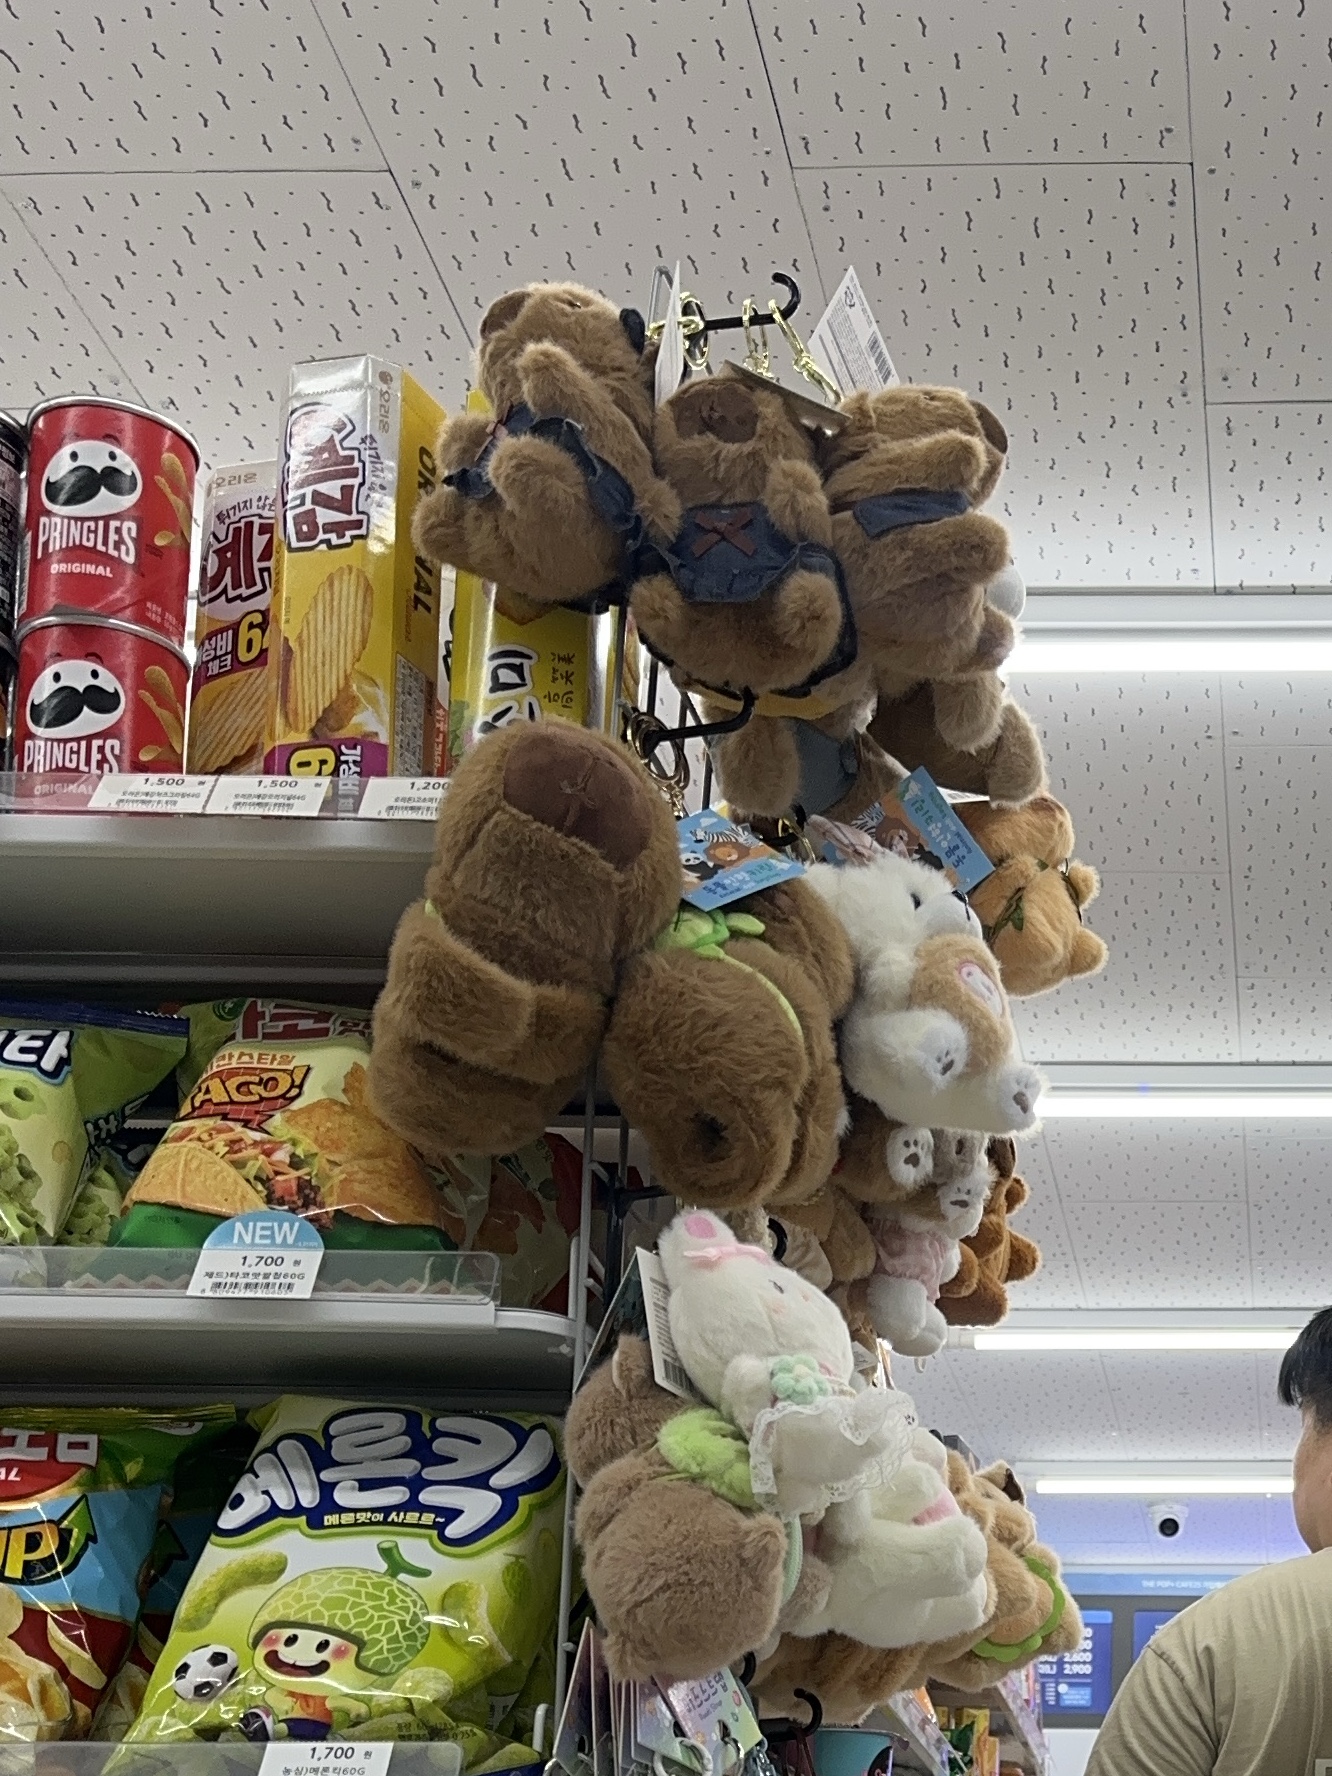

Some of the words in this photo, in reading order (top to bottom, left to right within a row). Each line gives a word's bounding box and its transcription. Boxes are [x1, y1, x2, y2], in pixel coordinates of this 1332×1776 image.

[214, 472, 258, 489] 오리온
[37, 515, 137, 565] PRINGLES
[50, 562, 114, 579] ORIGINAL
[24, 738, 122, 775] PRINGLES
[142, 777, 186, 788] 1,500
[255, 779, 299, 789] 1,500
[233, 1221, 300, 1245] NEW
[240, 1255, 286, 1269] 1,700
[216, 1411, 556, 1541] 메론킥
[1063, 1663, 1093, 1675] 2,900
[308, 1746, 356, 1762] 1,700
